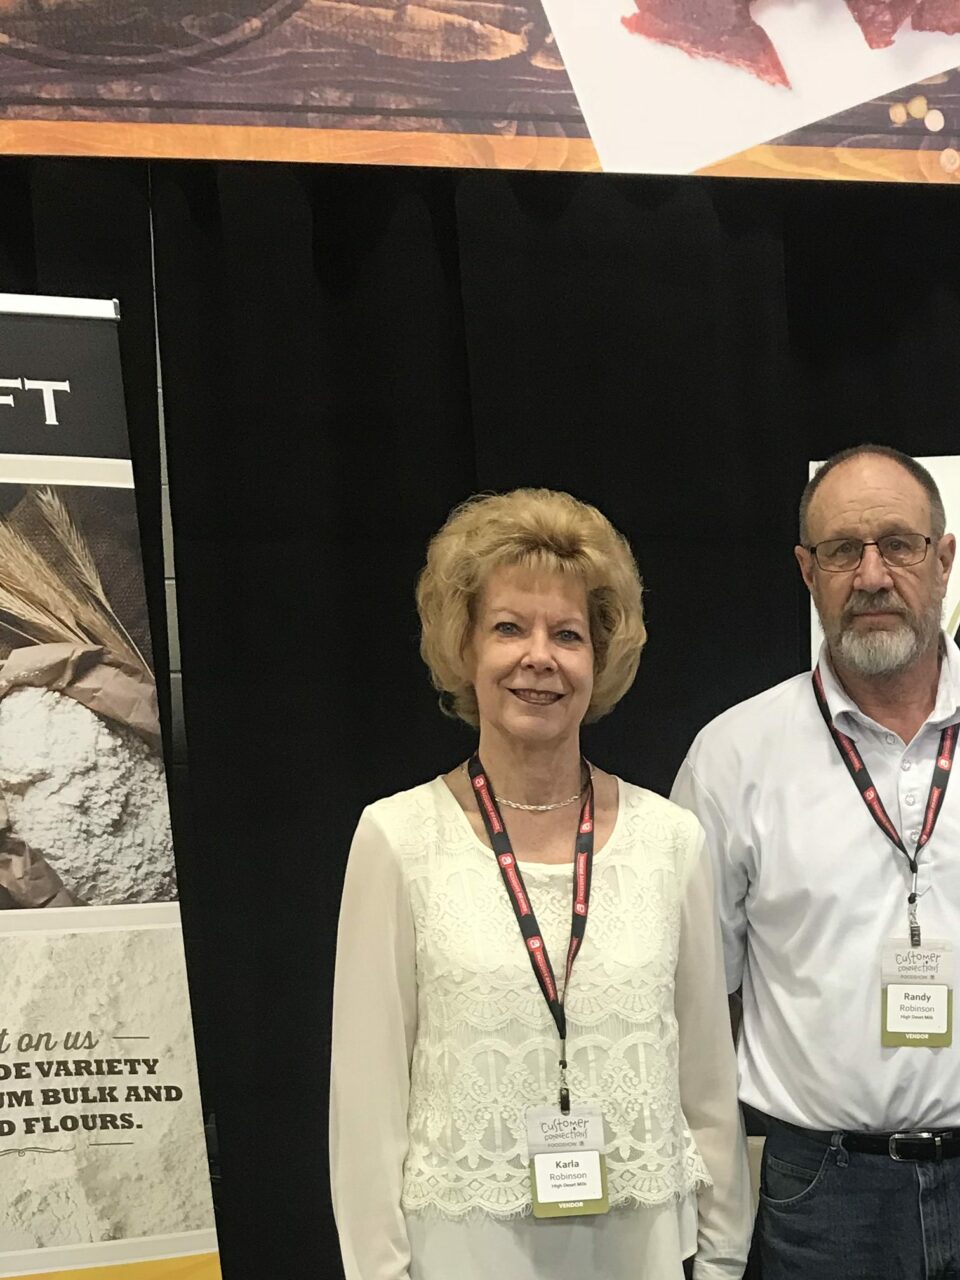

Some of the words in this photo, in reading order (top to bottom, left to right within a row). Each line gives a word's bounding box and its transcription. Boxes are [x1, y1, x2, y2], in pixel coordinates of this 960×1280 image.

[895, 951, 941, 965] Customer
[904, 993, 931, 1003] Randy
[899, 1004, 935, 1013] Robinson
[17, 1030, 57, 1053] on
[63, 1030, 99, 1051] us
[35, 1058, 159, 1078] VARIETY
[41, 1086, 119, 1106] BULK
[125, 1085, 183, 1102] AND
[23, 1113, 143, 1134] FLOURS.
[540, 1118, 590, 1134] Customer
[555, 1160, 580, 1169] Karla
[549, 1172, 587, 1181] Robinson
